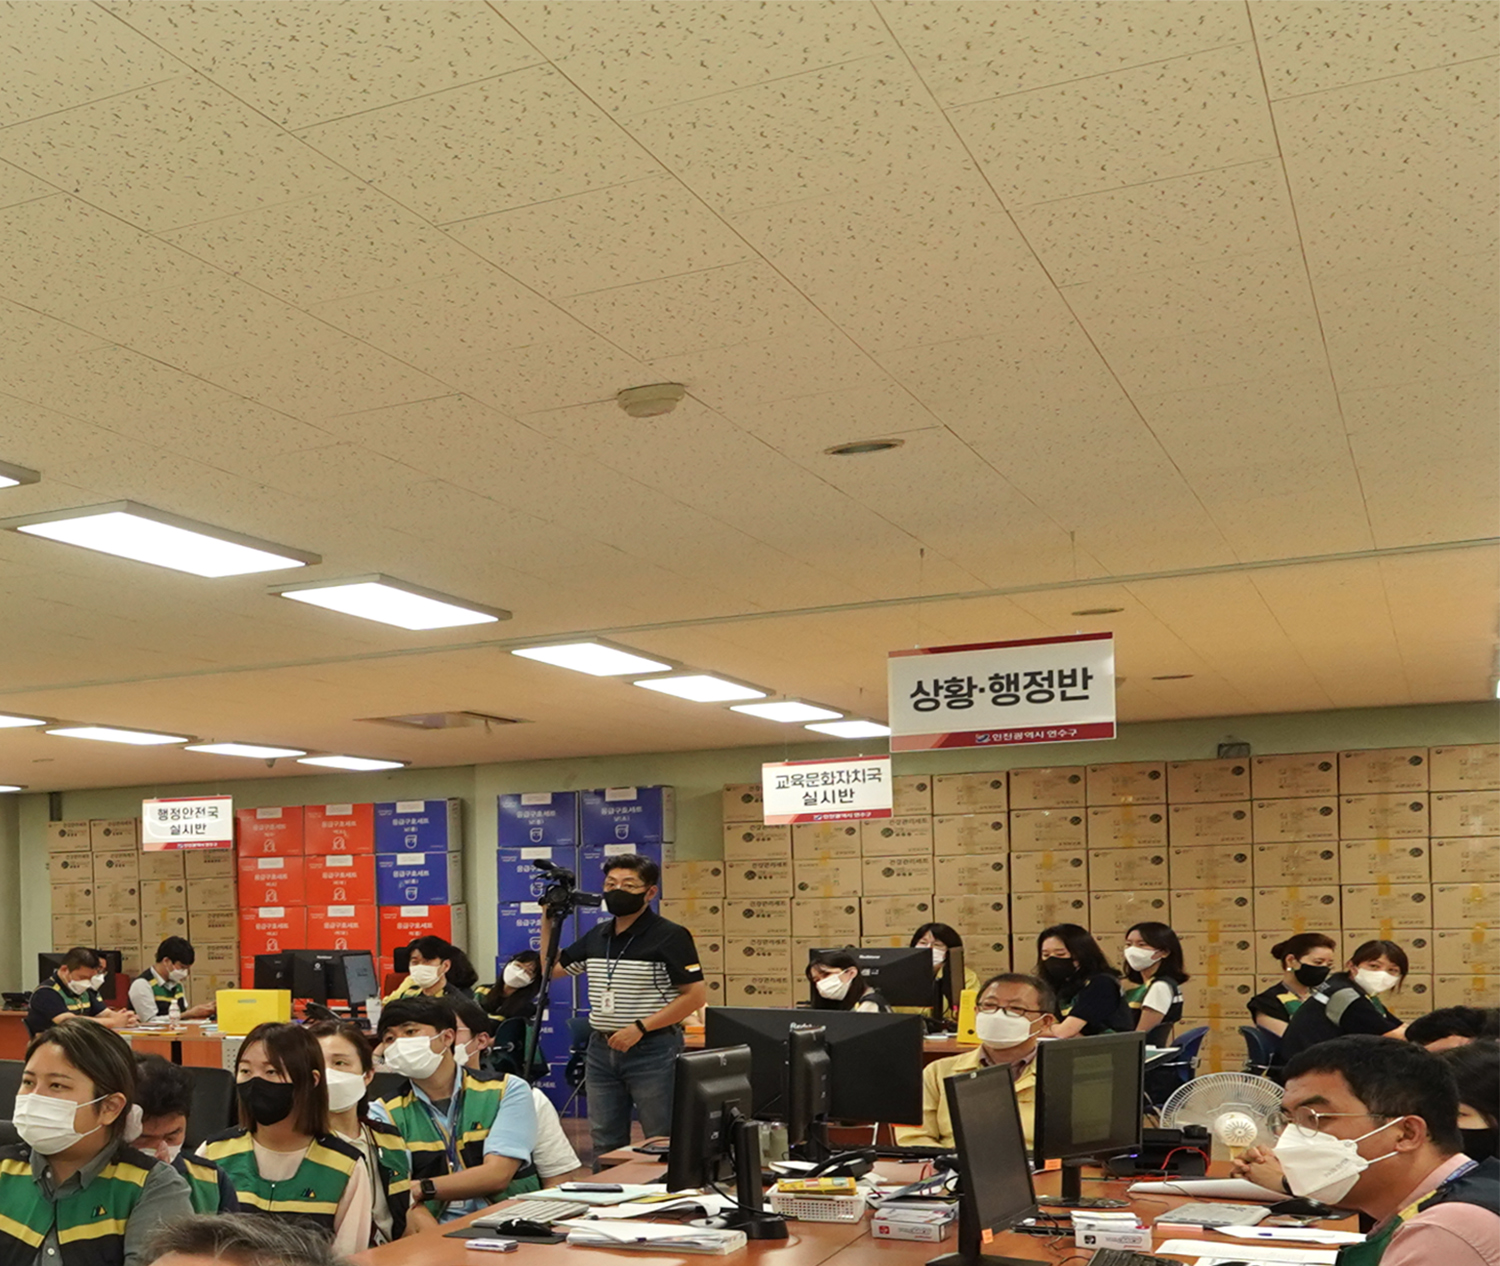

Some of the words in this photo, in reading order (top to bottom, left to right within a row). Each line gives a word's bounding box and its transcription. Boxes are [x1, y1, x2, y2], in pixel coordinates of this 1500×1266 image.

[909, 666, 1094, 712] 상황·행정반
[991, 731, 1045, 742] 인천광역시
[1046, 728, 1078, 739] 연수구
[775, 767, 883, 790] 교육문화자치국
[802, 787, 855, 807] 실시반
[157, 805, 219, 821] 행정안전국
[169, 823, 207, 836] 실시반
